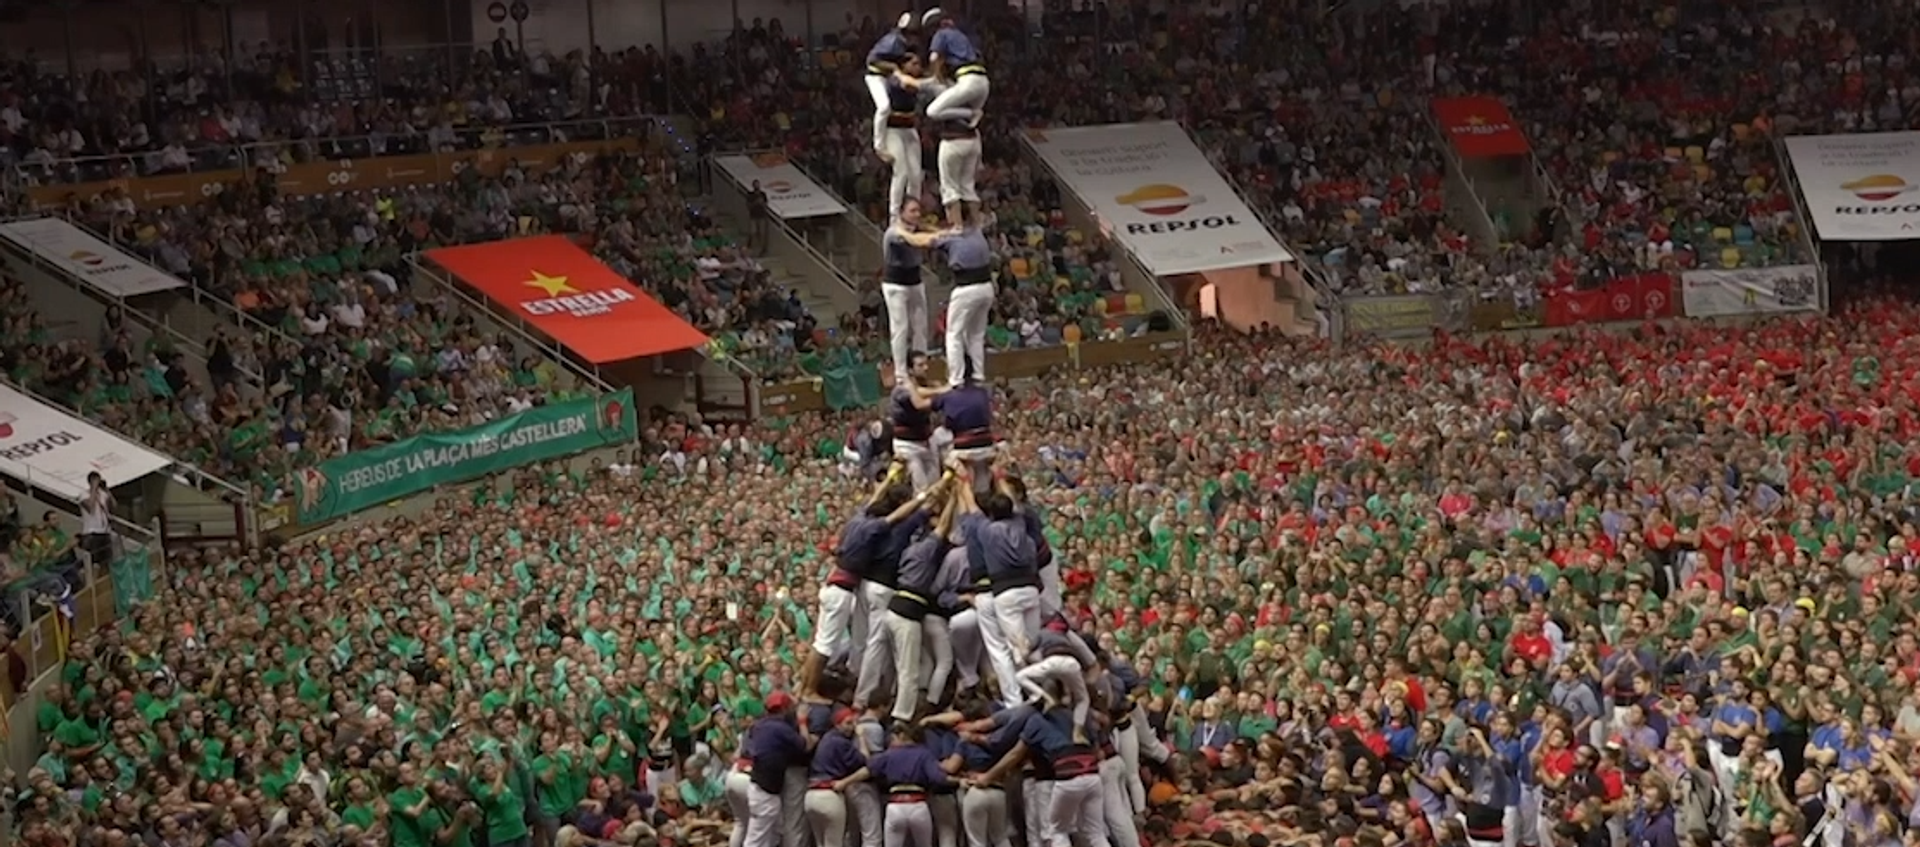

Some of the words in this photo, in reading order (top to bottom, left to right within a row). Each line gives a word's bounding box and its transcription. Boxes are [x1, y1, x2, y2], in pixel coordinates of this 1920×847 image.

[1126, 215, 1240, 235] REPSOL
[519, 287, 636, 316] ESTRELLA
[338, 464, 386, 494] HEREUS
[385, 456, 403, 480] DE
[422, 443, 469, 468] PLAÇA
